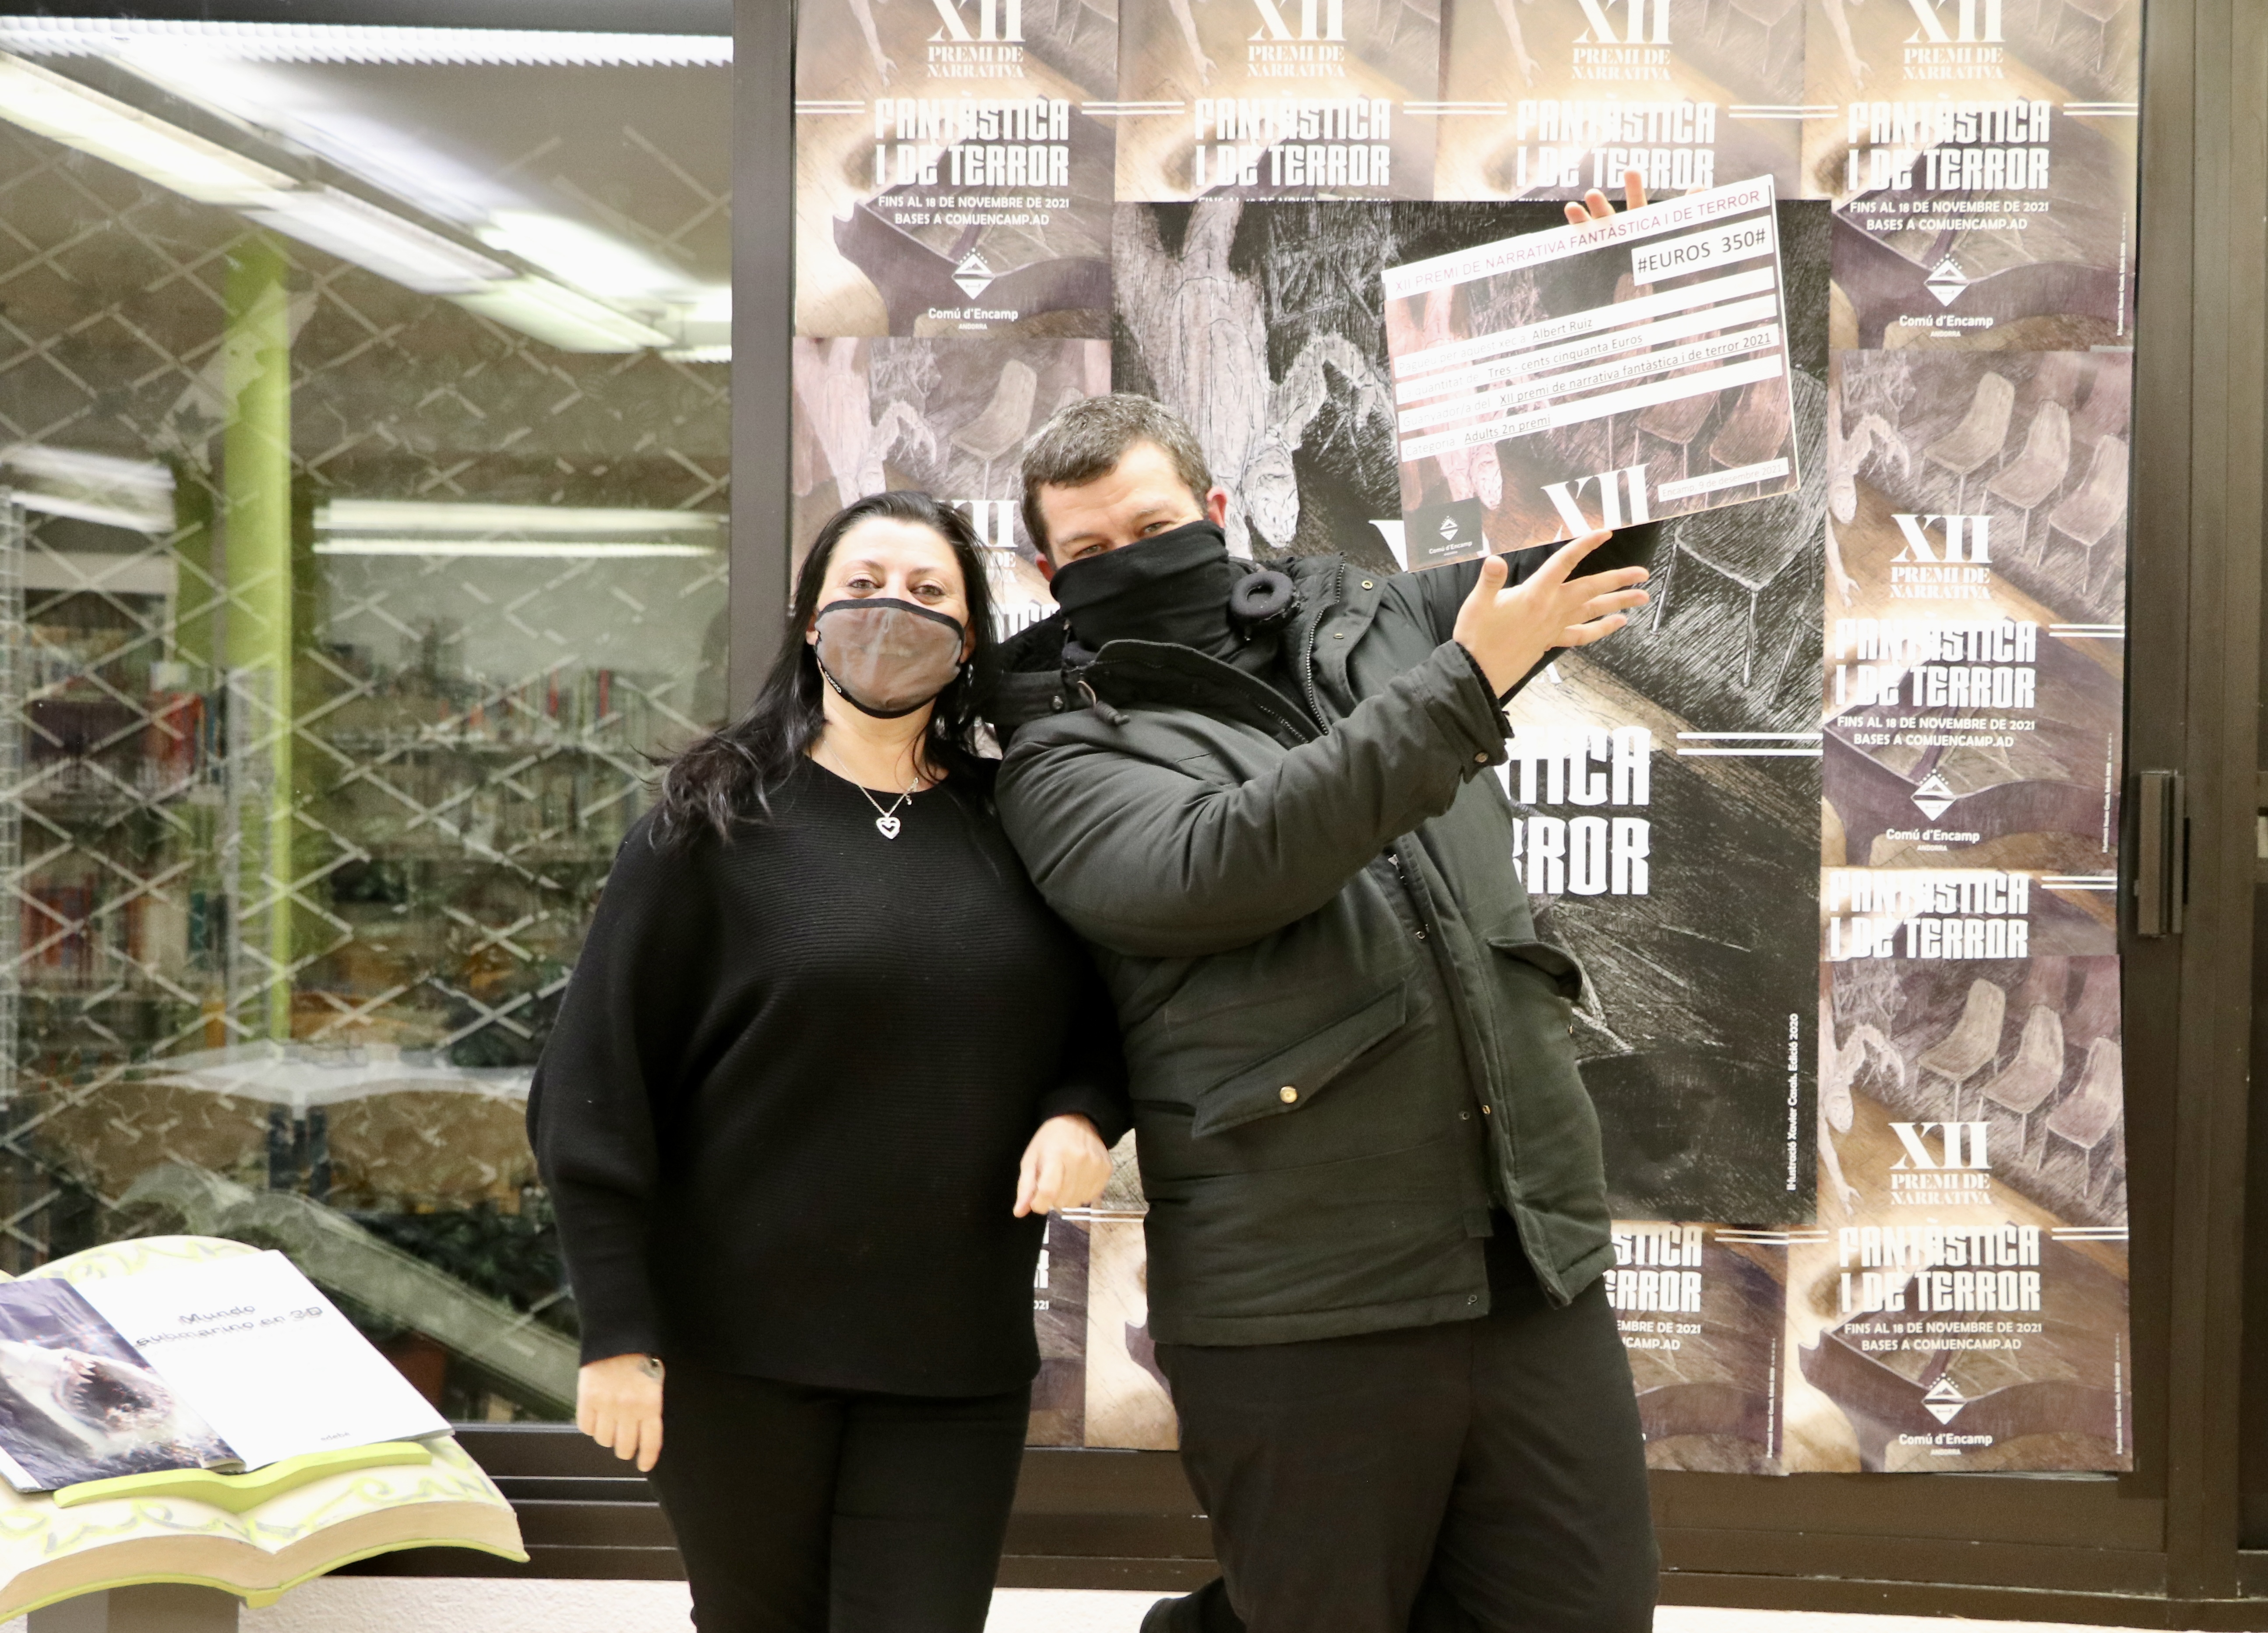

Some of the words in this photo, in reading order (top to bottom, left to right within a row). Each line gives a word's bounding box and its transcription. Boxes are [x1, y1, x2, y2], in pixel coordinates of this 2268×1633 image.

[927, 0, 1026, 42] XII
[1903, 0, 2006, 42] XII
[928, 46, 993, 62] PREMI
[996, 46, 1024, 62] DE
[1248, 46, 1315, 61] PREMI
[1318, 46, 1345, 61] DE
[1573, 48, 1642, 65] PREMI
[1644, 48, 1671, 65] DE
[1904, 47, 1973, 64] PREMI
[1977, 47, 2003, 64] DE
[927, 64, 1024, 78] NARRATIVA
[1248, 64, 1346, 77] NARRATIVA
[1572, 67, 1671, 81] NARRATIVA
[1903, 66, 2004, 79] NARRATIVA
[876, 145, 885, 185] I
[897, 145, 938, 186] DE
[948, 145, 1069, 187] TERROR
[1196, 145, 1206, 186] I
[1217, 145, 1258, 186] DE
[1268, 145, 1390, 186] TERROR
[1539, 147, 1579, 187] DE
[1849, 149, 1858, 190] I
[1871, 149, 1912, 190] DE
[1924, 148, 2049, 190] TERROR
[878, 196, 904, 207] FINS
[907, 197, 922, 207] AL
[926, 197, 936, 207] 18
[940, 197, 955, 208] DE
[959, 197, 1023, 208] NOVEMBRE
[1027, 198, 1042, 208] DE
[1045, 198, 1069, 208] 2021
[1850, 201, 1876, 212] FINS
[1880, 201, 1896, 212] AL
[1899, 201, 1909, 212] 18
[1913, 201, 1929, 212] DE
[1933, 201, 2001, 212] NOVEMBRE
[2004, 201, 2020, 212] DE
[2024, 201, 2049, 212] 2021
[895, 213, 930, 225] BASES
[933, 214, 942, 225] A
[945, 214, 1049, 226] COMUENCAMP.AD
[1867, 219, 1903, 231] BASES
[1906, 219, 1915, 231] A
[1919, 219, 2028, 230] COMUENCAMP.AD
[1396, 280, 1411, 292] XII
[1415, 268, 1458, 288] PREMI
[1463, 262, 1481, 278] DE
[1486, 241, 1566, 269] NARRATIVA
[1570, 216, 1660, 248] FANTÀSTICA
[1665, 211, 1668, 224] I
[1674, 204, 1693, 222] DE
[1697, 191, 1759, 217] TERROR
[1638, 242, 1711, 273] #EUROS
[1721, 229, 1766, 253] 350#
[928, 308, 960, 320] Comú
[1899, 315, 1933, 326] Comú
[1461, 342, 1495, 360] aquest
[1499, 338, 1516, 348] xec
[1533, 324, 1567, 340] Albert
[1570, 317, 1593, 331] Ruiz
[1467, 373, 1478, 382] de
[1488, 367, 1510, 377] Tres
[1522, 356, 1550, 370] cents
[1554, 342, 1608, 363] cinquanta
[1612, 333, 1643, 349] Euros
[1474, 398, 1490, 410] del
[1500, 393, 1513, 404] XII
[1517, 387, 1548, 402] premi
[1553, 378, 1565, 392] de
[1570, 369, 1620, 389] narrativa
[1622, 357, 1679, 376] fantàstica
[1687, 348, 1702, 361] de
[1705, 342, 1739, 357] terror
[1743, 332, 1771, 349] 2021
[1406, 438, 1455, 455] Categoria
[1465, 427, 1499, 443] Adults
[1503, 424, 1515, 434] 2n
[1519, 415, 1550, 432] premi
[1707, 479, 1716, 487] de
[1718, 471, 1759, 485] desembre
[1762, 465, 1781, 476] 2021
[1541, 463, 1651, 541] XII
[1891, 514, 1994, 563] XII
[1891, 567, 1959, 583] PREMI
[1962, 567, 1990, 583] DE
[1890, 585, 1991, 599] NARRATIVA
[1836, 665, 1846, 705] I
[1858, 666, 1899, 705] DE
[1911, 667, 2035, 708] TERROR
[1838, 716, 1863, 727] FINS
[1867, 717, 1883, 727] AL
[1886, 718, 1896, 728] 18
[1900, 718, 1916, 729] DE
[1919, 718, 1986, 730] NOVEMBRE
[1990, 720, 2006, 730] DE
[2010, 720, 2035, 731] 2021
[1854, 734, 1890, 745] BASES
[1893, 735, 1902, 745] A
[1906, 735, 2014, 747] COMUENCAMP.AD
[1886, 829, 1919, 840] Comú
[1513, 815, 1650, 896] ROR
[1831, 917, 1840, 957] I
[1852, 917, 1893, 958] DE
[1904, 918, 2028, 959] TERROR
[1790, 1013, 1798, 1040] 2020
[1788, 1042, 1798, 1071] Edició
[1788, 1107, 1797, 1139] Xavier
[1888, 1122, 1992, 1169] XII
[1891, 1173, 1960, 1189] PREMI
[1962, 1173, 1990, 1189] DE
[1891, 1192, 1991, 1205] NARRATIVA
[1602, 1270, 1702, 1312] ERROR
[1841, 1273, 1851, 1312] I
[1863, 1272, 1905, 1312] DE
[1915, 1271, 2041, 1312] TERROR
[178, 1305, 255, 1324] Mundo
[135, 1322, 254, 1348] submarino
[260, 1315, 285, 1327] en
[290, 1307, 322, 1321] 3D
[1617, 1320, 1654, 1333] EMBRE
[1658, 1322, 1673, 1333] DE
[1677, 1324, 1701, 1334] 2021
[1845, 1323, 1870, 1334] FINS
[1875, 1323, 1890, 1334] AL
[1893, 1323, 1904, 1333] 18
[1907, 1323, 1923, 1333] DE
[1927, 1323, 1994, 1333] NOVEMBRE
[1997, 1323, 2014, 1333] DE
[2017, 1322, 2042, 1333] 2021
[1862, 1340, 1898, 1351] BASES
[1901, 1340, 1910, 1350] A
[1914, 1339, 2021, 1350] COMUENCAMP.AD
[1899, 1434, 1932, 1445] Comú
